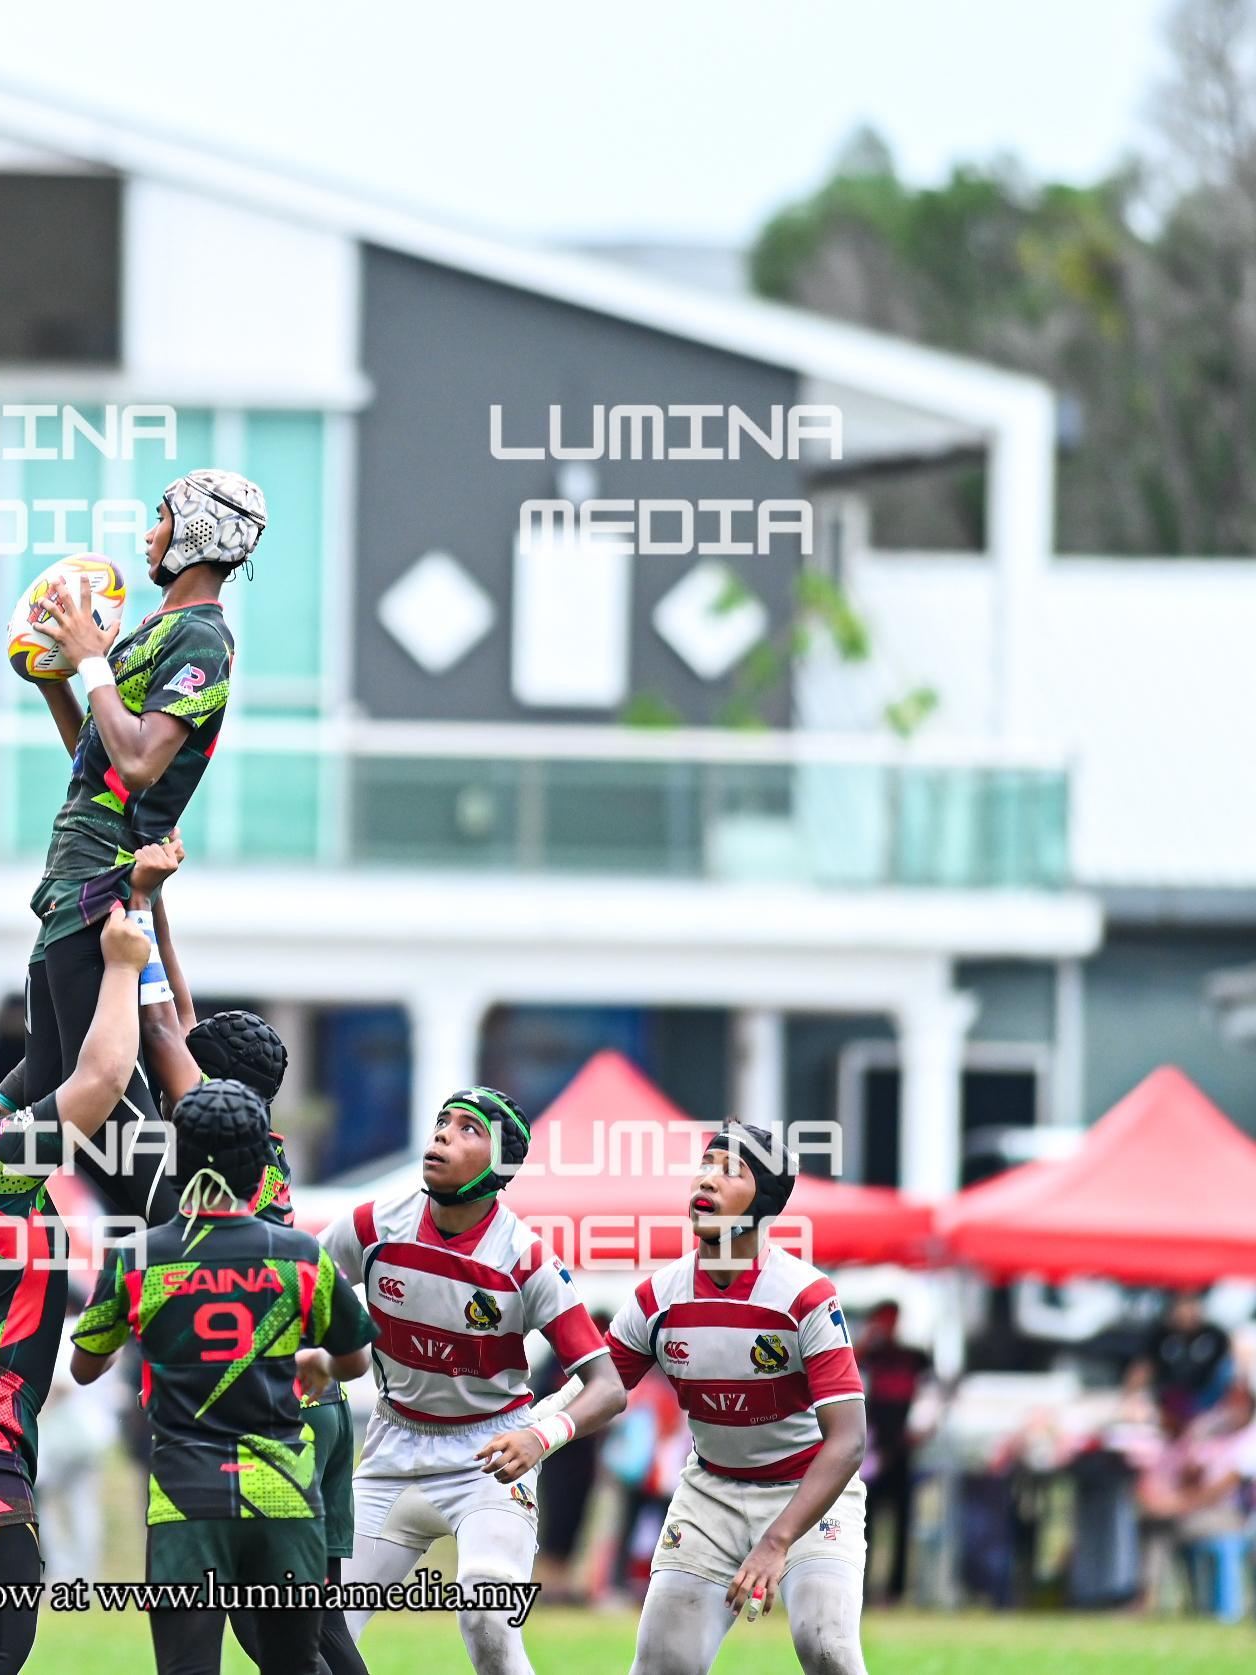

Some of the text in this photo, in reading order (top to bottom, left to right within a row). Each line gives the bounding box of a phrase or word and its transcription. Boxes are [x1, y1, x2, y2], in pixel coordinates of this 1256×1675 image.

[163, 1267, 284, 1296] SAINA
[193, 1302, 255, 1361] 9
[410, 1335, 454, 1362] NFZ
[701, 1393, 748, 1412] NFZ
[749, 1413, 778, 1425] group
